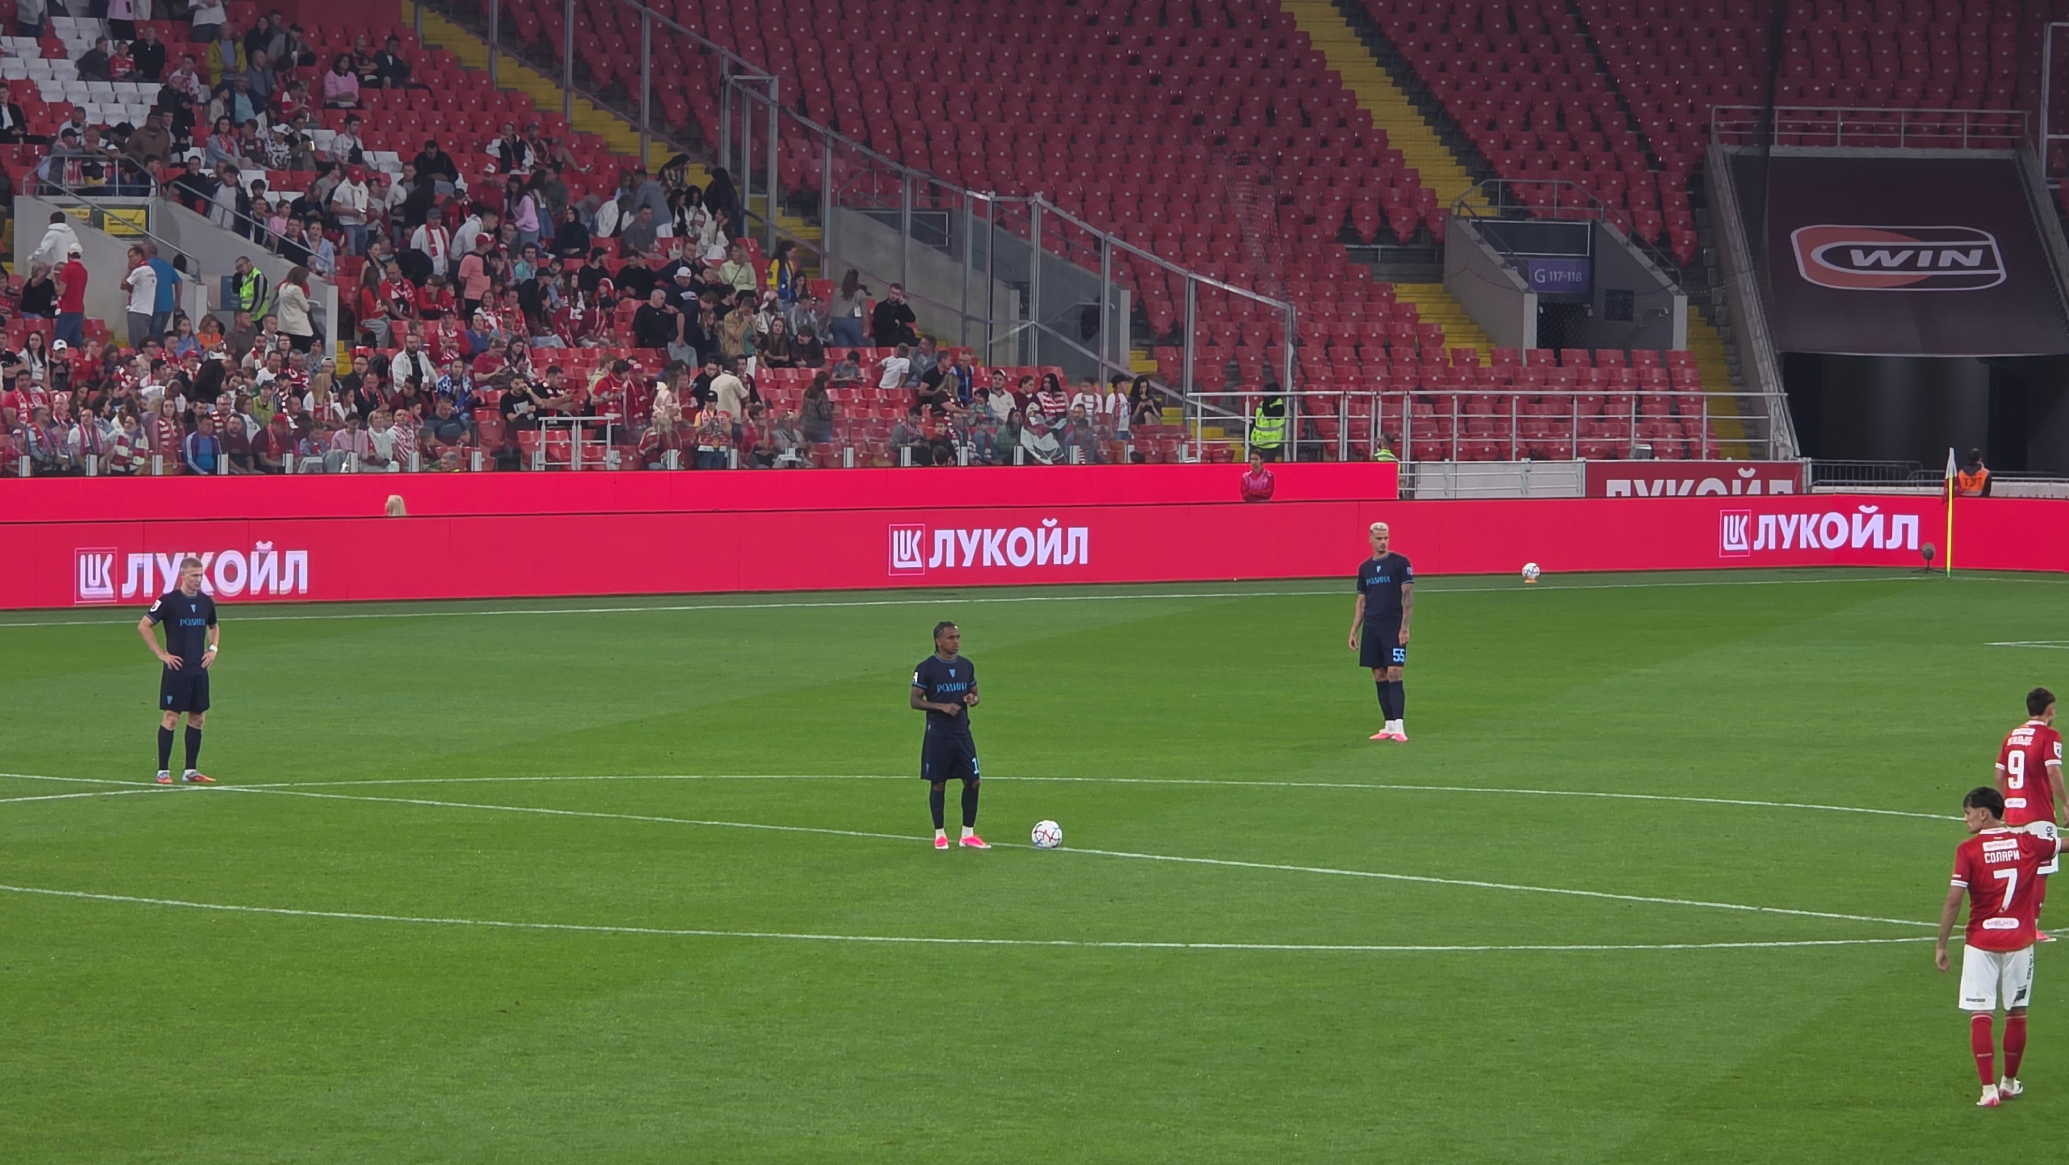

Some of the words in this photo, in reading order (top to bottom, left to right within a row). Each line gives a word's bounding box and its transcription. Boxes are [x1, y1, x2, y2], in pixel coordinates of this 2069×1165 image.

[1850, 249, 1983, 267] WIN
[1534, 268, 1546, 283] G
[1549, 271, 1582, 282] 117-118
[1754, 505, 1918, 550] ЛУКОЙЛ
[929, 518, 1088, 568] ЛУКОЙЛ
[1392, 648, 1405, 662] 55
[2008, 750, 2025, 789] 9
[1984, 850, 2020, 864] СОЛАРИ
[1993, 868, 2018, 913] 7
